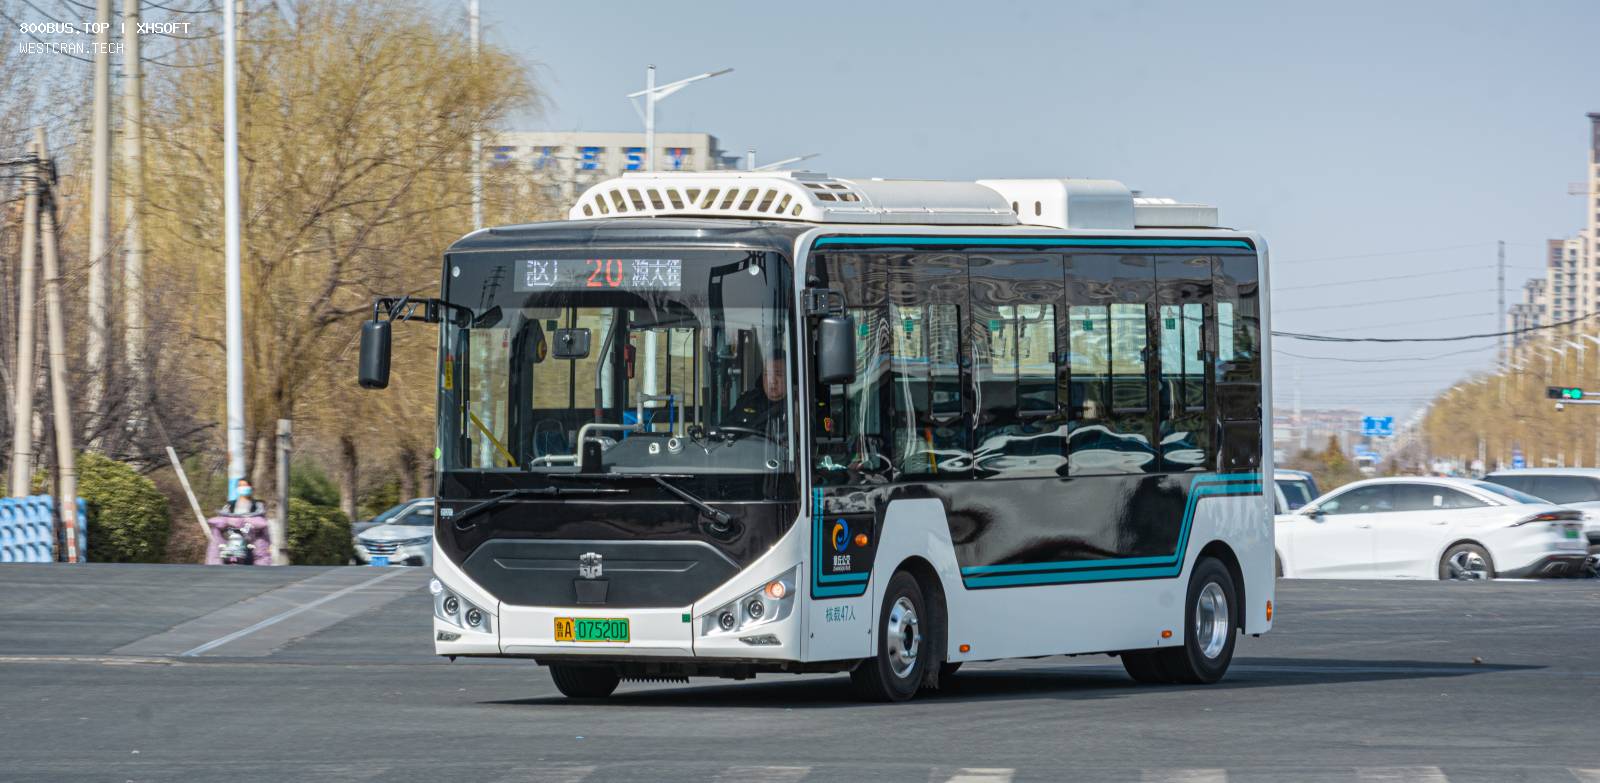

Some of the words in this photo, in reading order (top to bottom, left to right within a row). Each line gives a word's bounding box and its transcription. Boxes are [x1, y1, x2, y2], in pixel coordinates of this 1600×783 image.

[585, 258, 623, 287] 20
[825, 605, 856, 623] 核载47人
